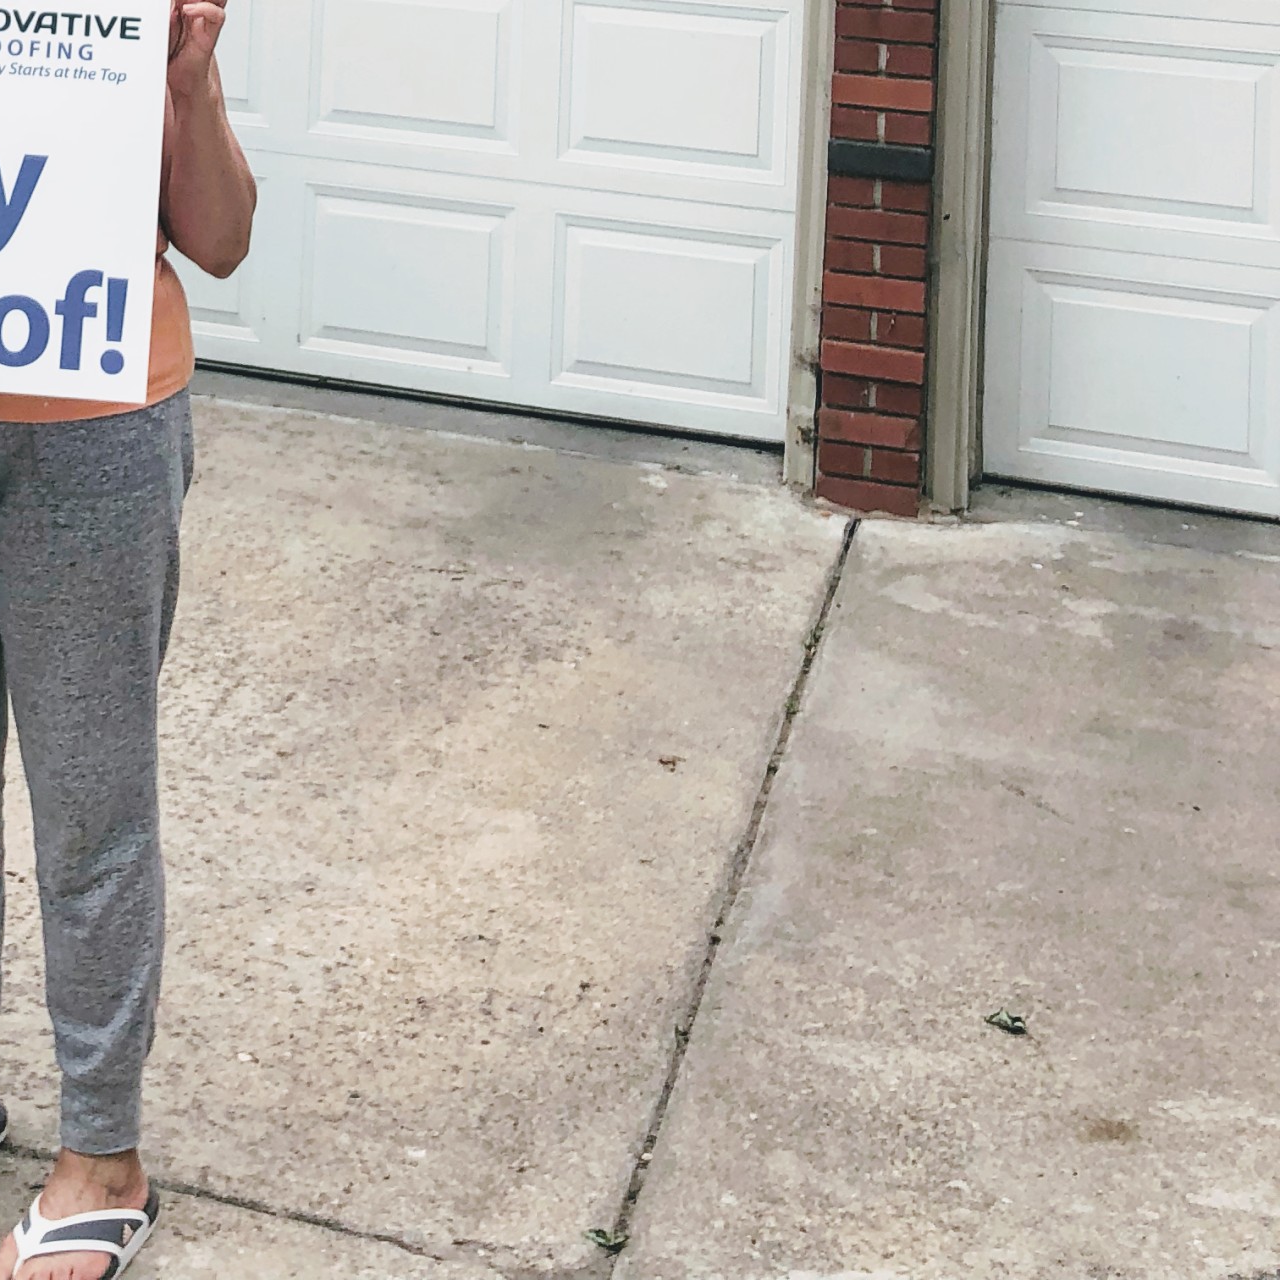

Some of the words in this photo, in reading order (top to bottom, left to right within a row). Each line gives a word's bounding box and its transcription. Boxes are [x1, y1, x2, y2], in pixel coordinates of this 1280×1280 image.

[9, 62, 51, 78] Starts
[54, 67, 70, 79] at
[72, 66, 96, 80] the
[101, 68, 127, 85] Top
